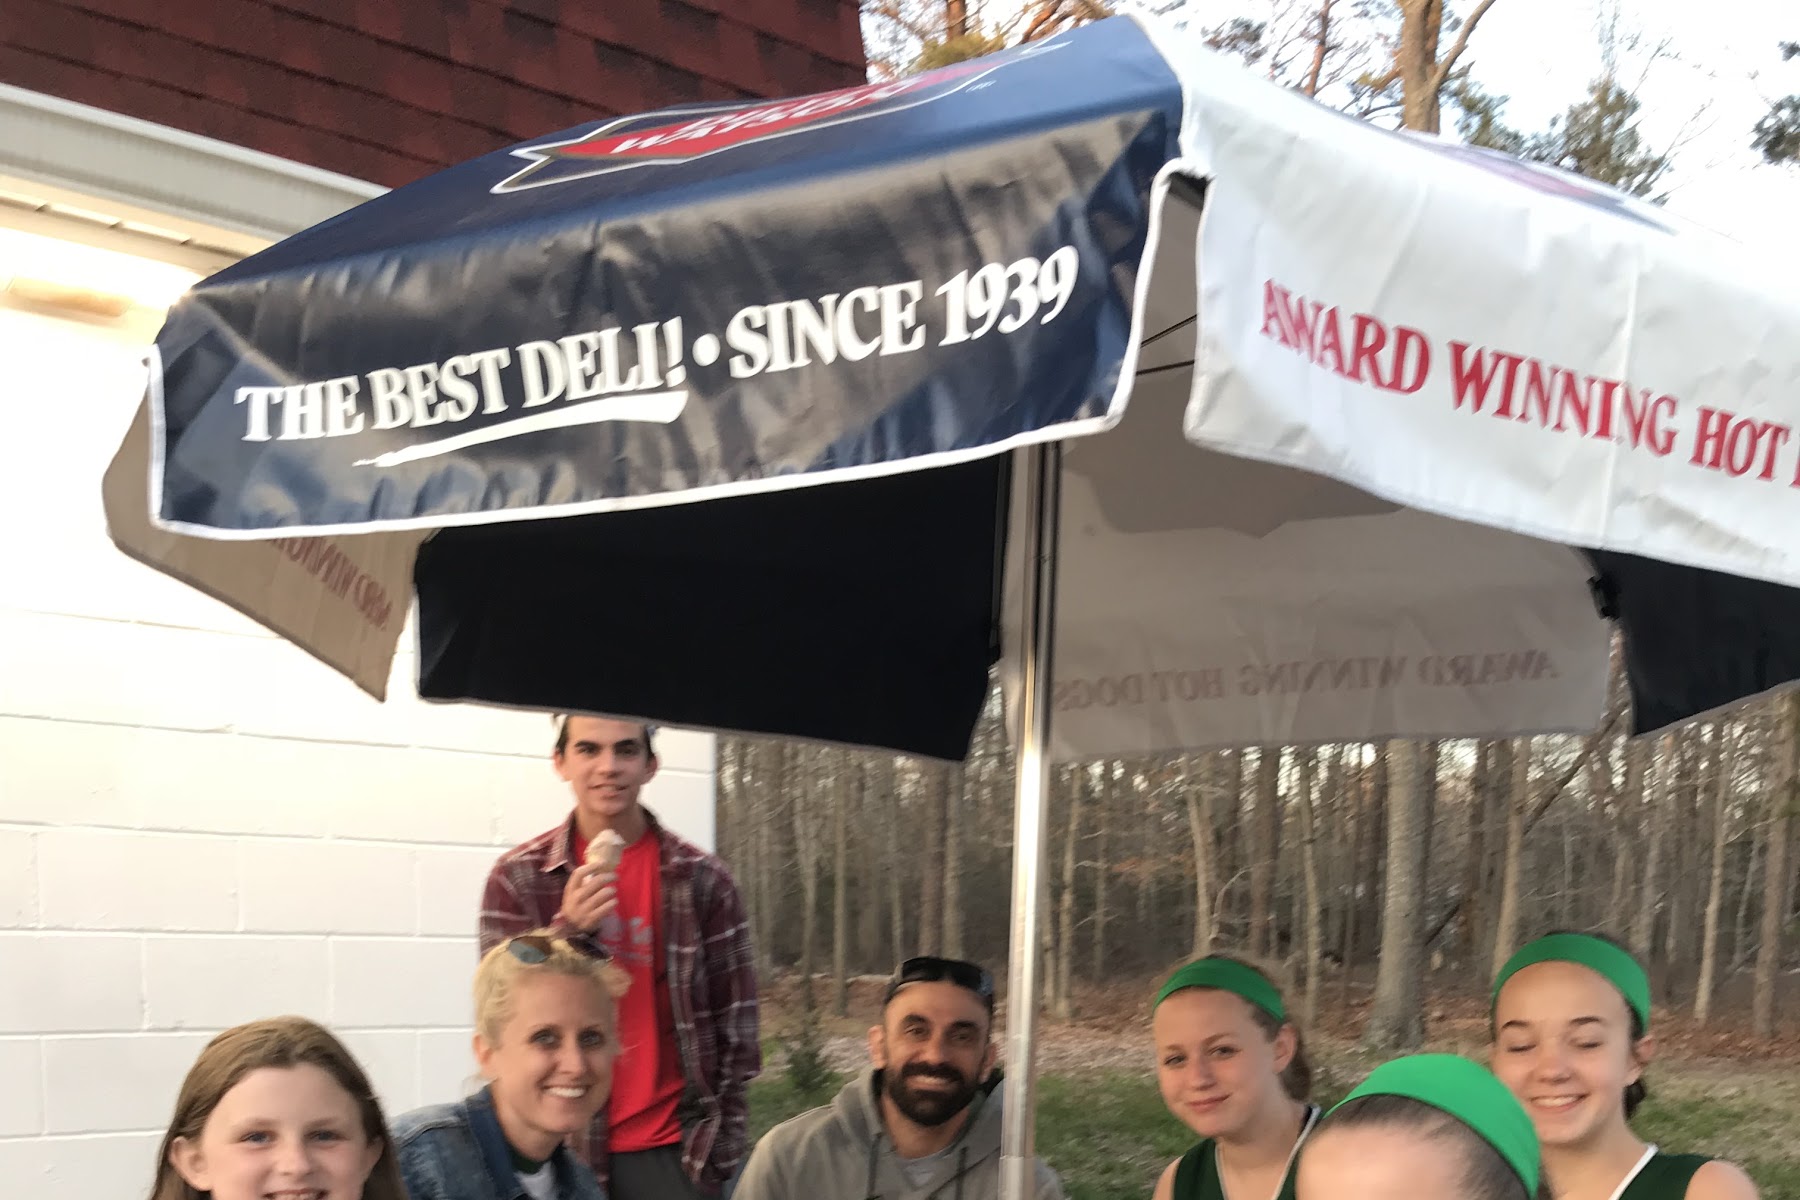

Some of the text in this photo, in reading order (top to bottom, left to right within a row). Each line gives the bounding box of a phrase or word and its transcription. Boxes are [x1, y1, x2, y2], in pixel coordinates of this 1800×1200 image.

[235, 316, 688, 442] THE BEST DELI!
[726, 245, 1079, 379] SINCE 1939
[1260, 277, 1432, 395] AWARD
[1447, 340, 1681, 458] WINNING
[1688, 405, 1791, 482] HOT
